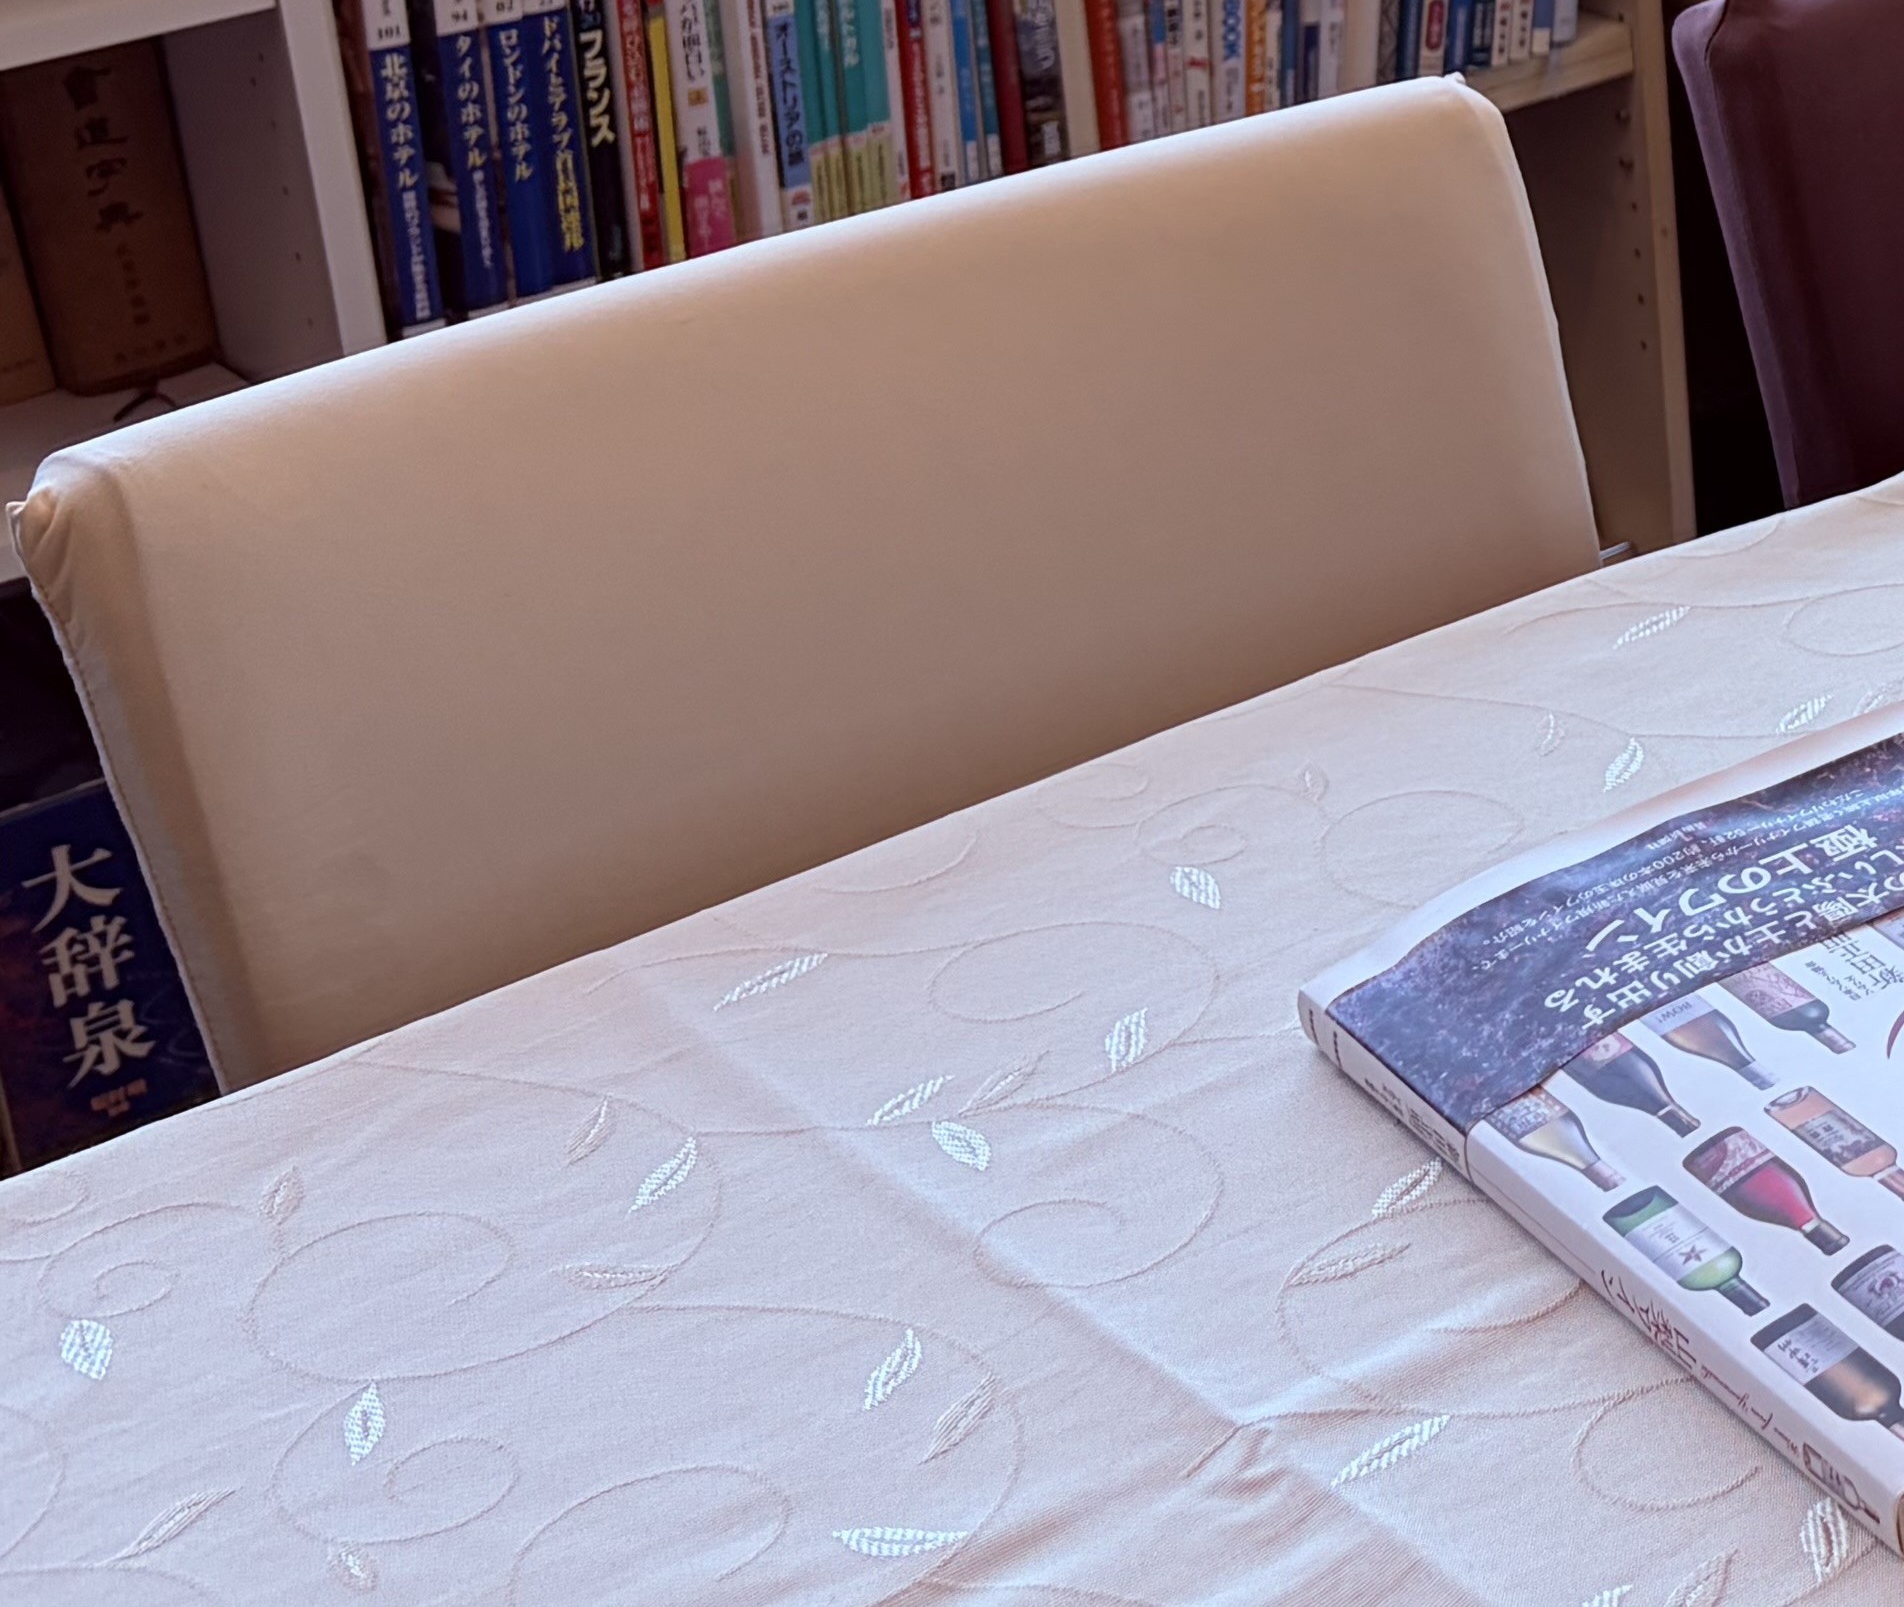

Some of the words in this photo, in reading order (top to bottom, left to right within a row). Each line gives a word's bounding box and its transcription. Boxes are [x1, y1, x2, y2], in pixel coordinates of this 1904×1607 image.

[381, 50, 419, 190] 北京のホテル
[454, 33, 489, 169] タイのホテル
[497, 28, 534, 183] ロンドンのホテル
[579, 29, 616, 148] フランス
[1596, 821, 1884, 957] 極上のワイン
[22, 843, 157, 1090] 大辞泉
[1590, 1261, 1708, 1371] 山梨ワイン
